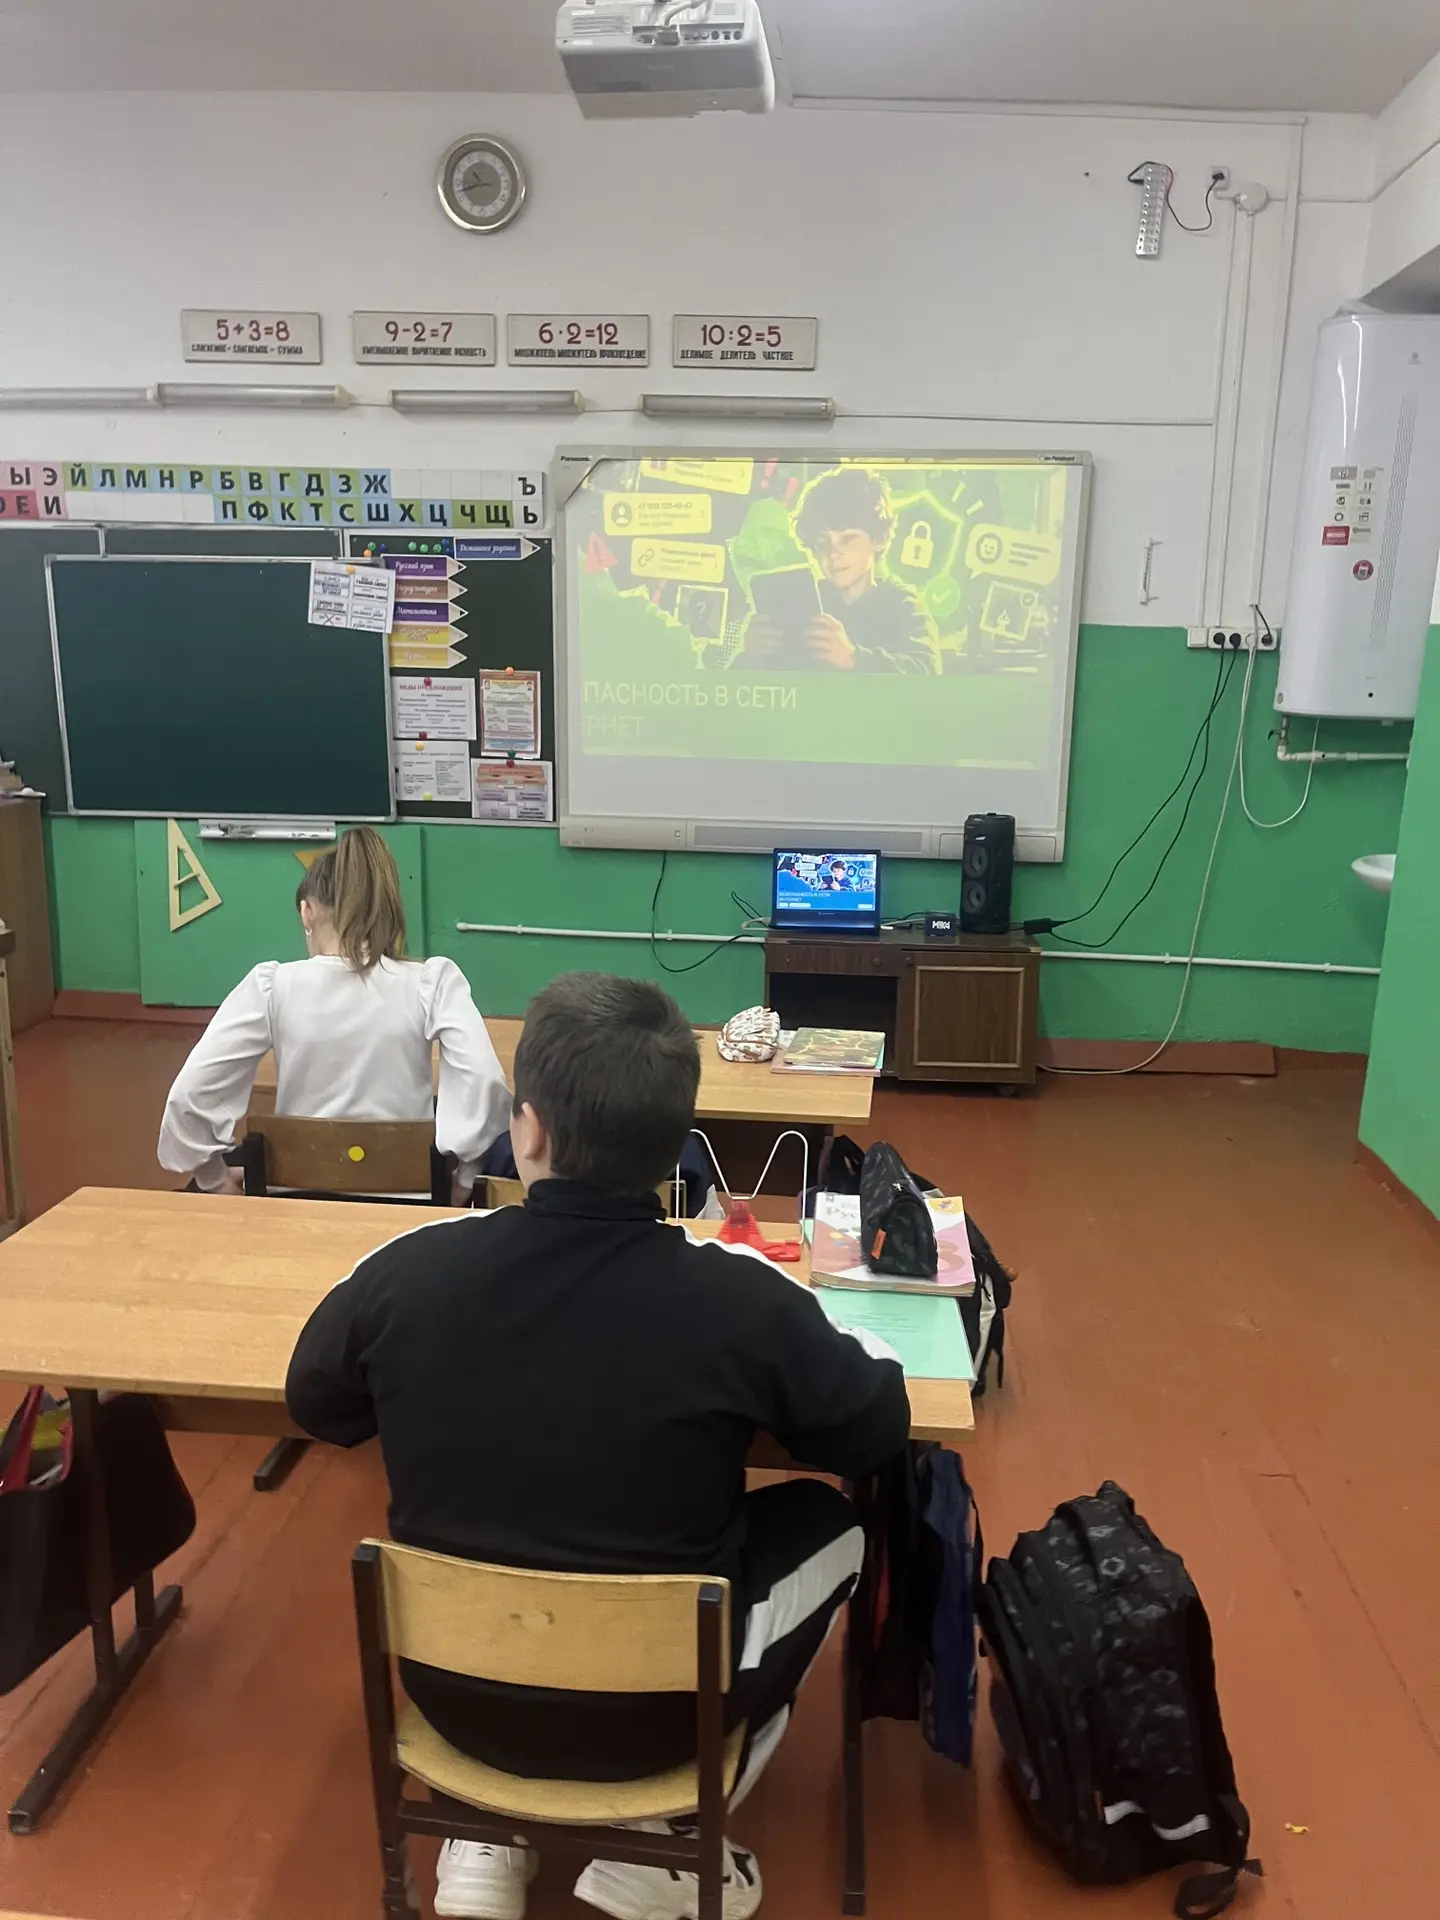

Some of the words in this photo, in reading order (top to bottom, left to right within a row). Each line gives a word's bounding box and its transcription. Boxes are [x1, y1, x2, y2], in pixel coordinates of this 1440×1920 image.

[680, 349, 713, 359] ДЕЛИМОЕ
[720, 350, 756, 360] ДЕЛИТЕЛЬ
[762, 351, 794, 361] ЧАСТНОЕ
[10, 467, 30, 485] Ы
[43, 467, 58, 486] Э
[70, 463, 87, 486] Й
[100, 469, 116, 487] Л
[126, 469, 147, 488] М
[160, 470, 175, 488] Н
[190, 470, 204, 489] Р
[219, 471, 235, 490] Б
[249, 472, 264, 491] В
[279, 473, 290, 491] Г
[305, 474, 324, 496] Д
[338, 474, 352, 493] З
[363, 475, 388, 493] Ж
[518, 477, 536, 495] Ъ
[16, 496, 30, 514] Е
[44, 496, 61, 515] И
[221, 501, 237, 520] П
[248, 500, 268, 520] Ф
[281, 502, 297, 520] К
[309, 503, 323, 521] Т
[339, 503, 354, 522] С
[367, 504, 389, 522] Ш
[400, 504, 416, 522] Х
[430, 504, 447, 526] Ц
[460, 505, 475, 523] Ч
[486, 505, 511, 527] Щ
[523, 506, 538, 524] Ь
[714, 684, 729, 707] В
[735, 685, 798, 709] СЕТИ
